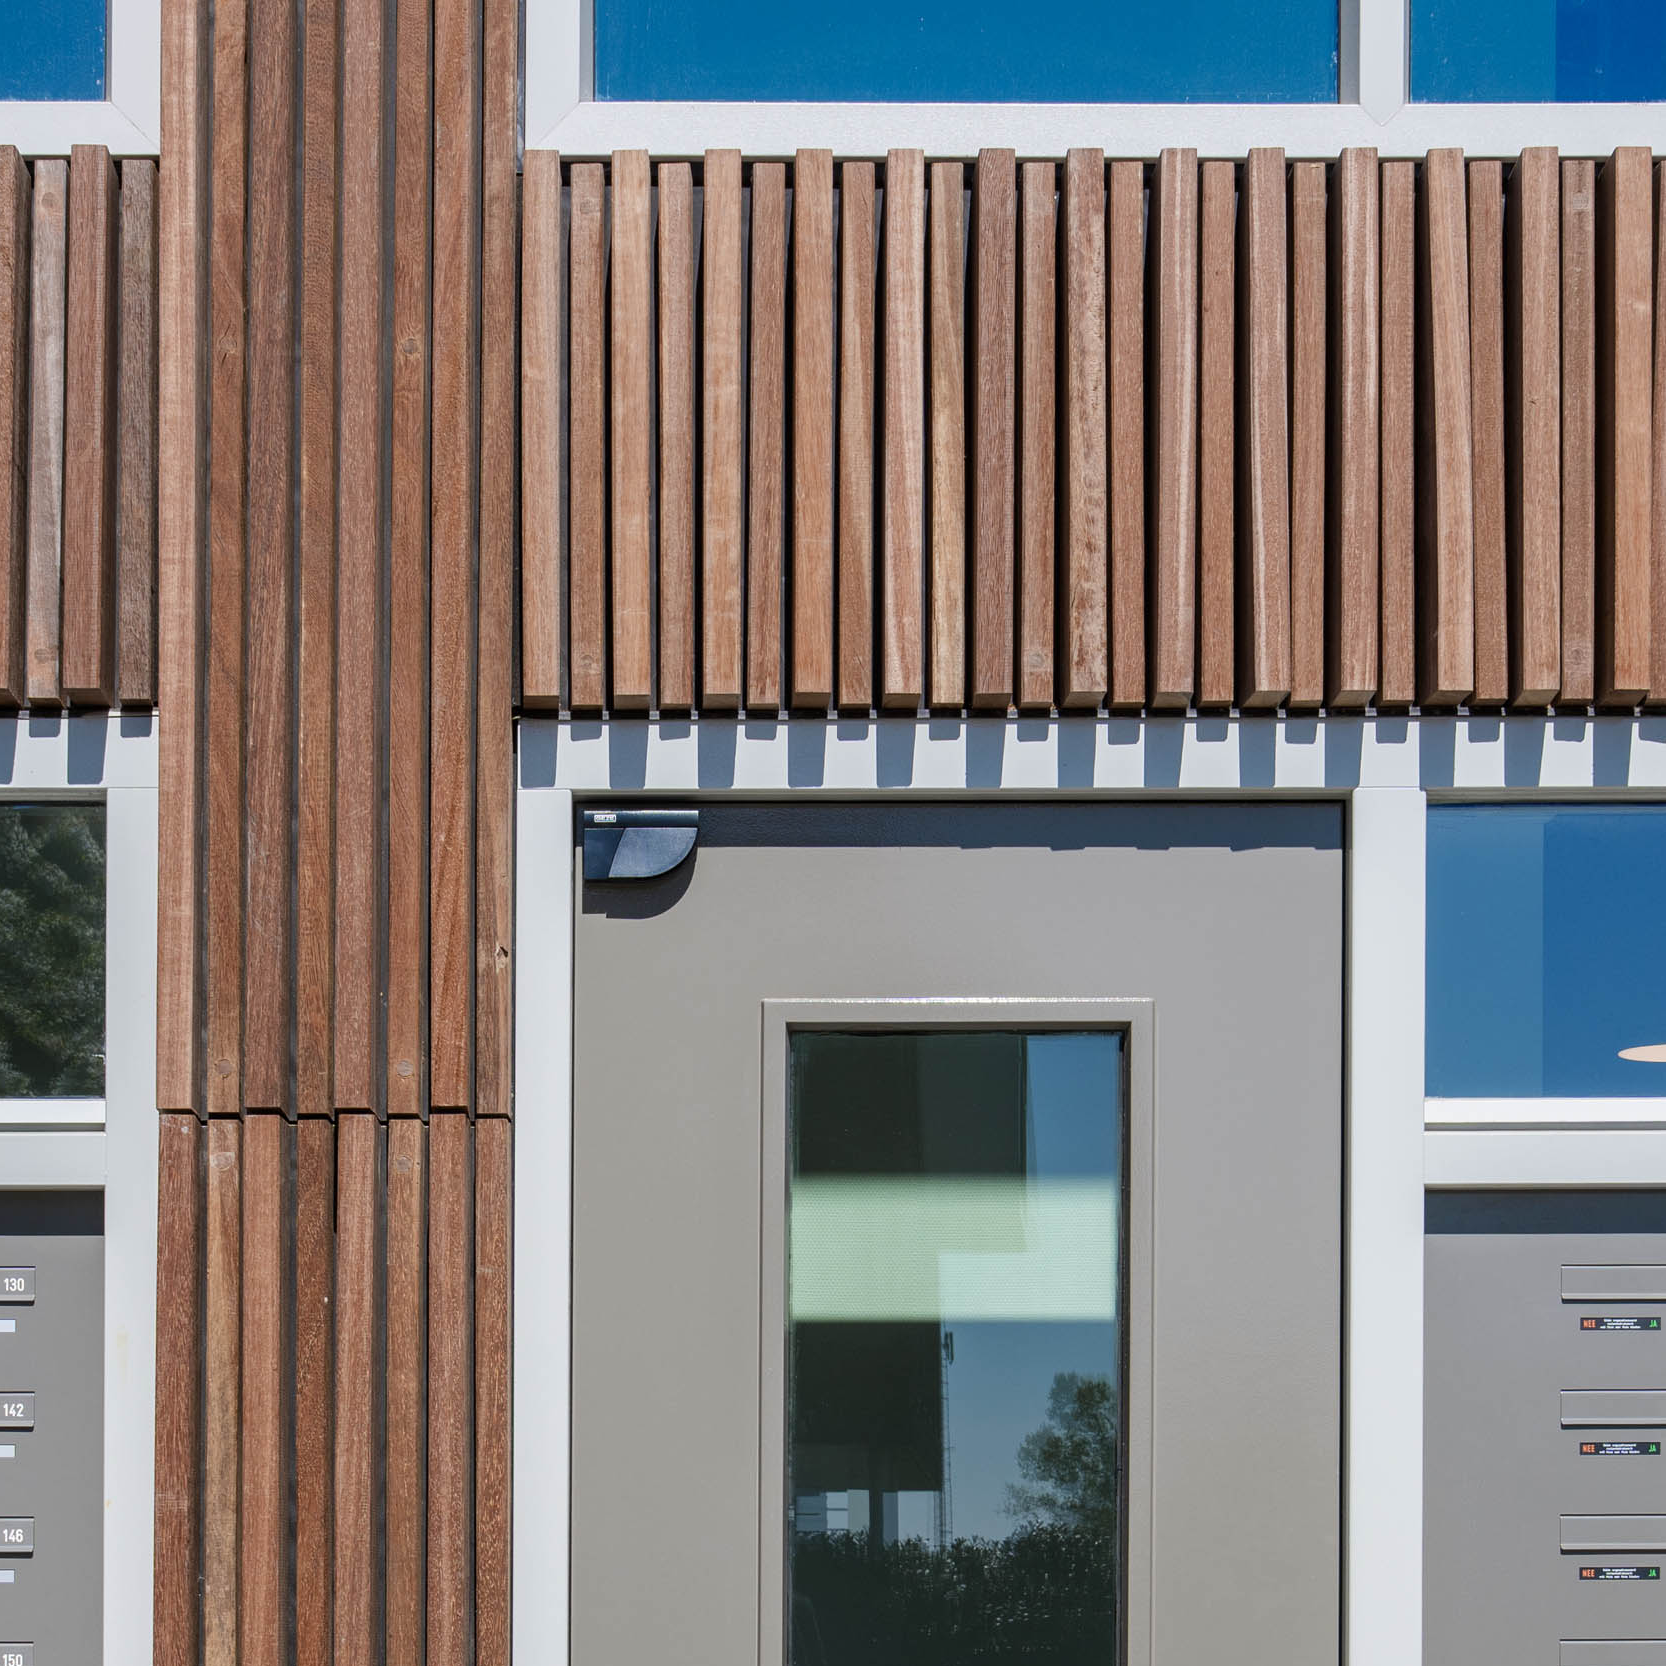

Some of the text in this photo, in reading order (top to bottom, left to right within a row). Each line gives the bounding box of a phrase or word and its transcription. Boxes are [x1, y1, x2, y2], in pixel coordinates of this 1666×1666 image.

[4, 1278, 24, 1291] 130
[1583, 1320, 1596, 1328] NEE
[1649, 1320, 1657, 1328] JA
[3, 1403, 24, 1417] 142
[1582, 1445, 1595, 1453] NEE
[1649, 1445, 1657, 1453] JA
[3, 1529, 23, 1542] 146
[1582, 1569, 1594, 1577] NEE
[1648, 1569, 1656, 1577] JA
[2, 1654, 23, 1666] 150
